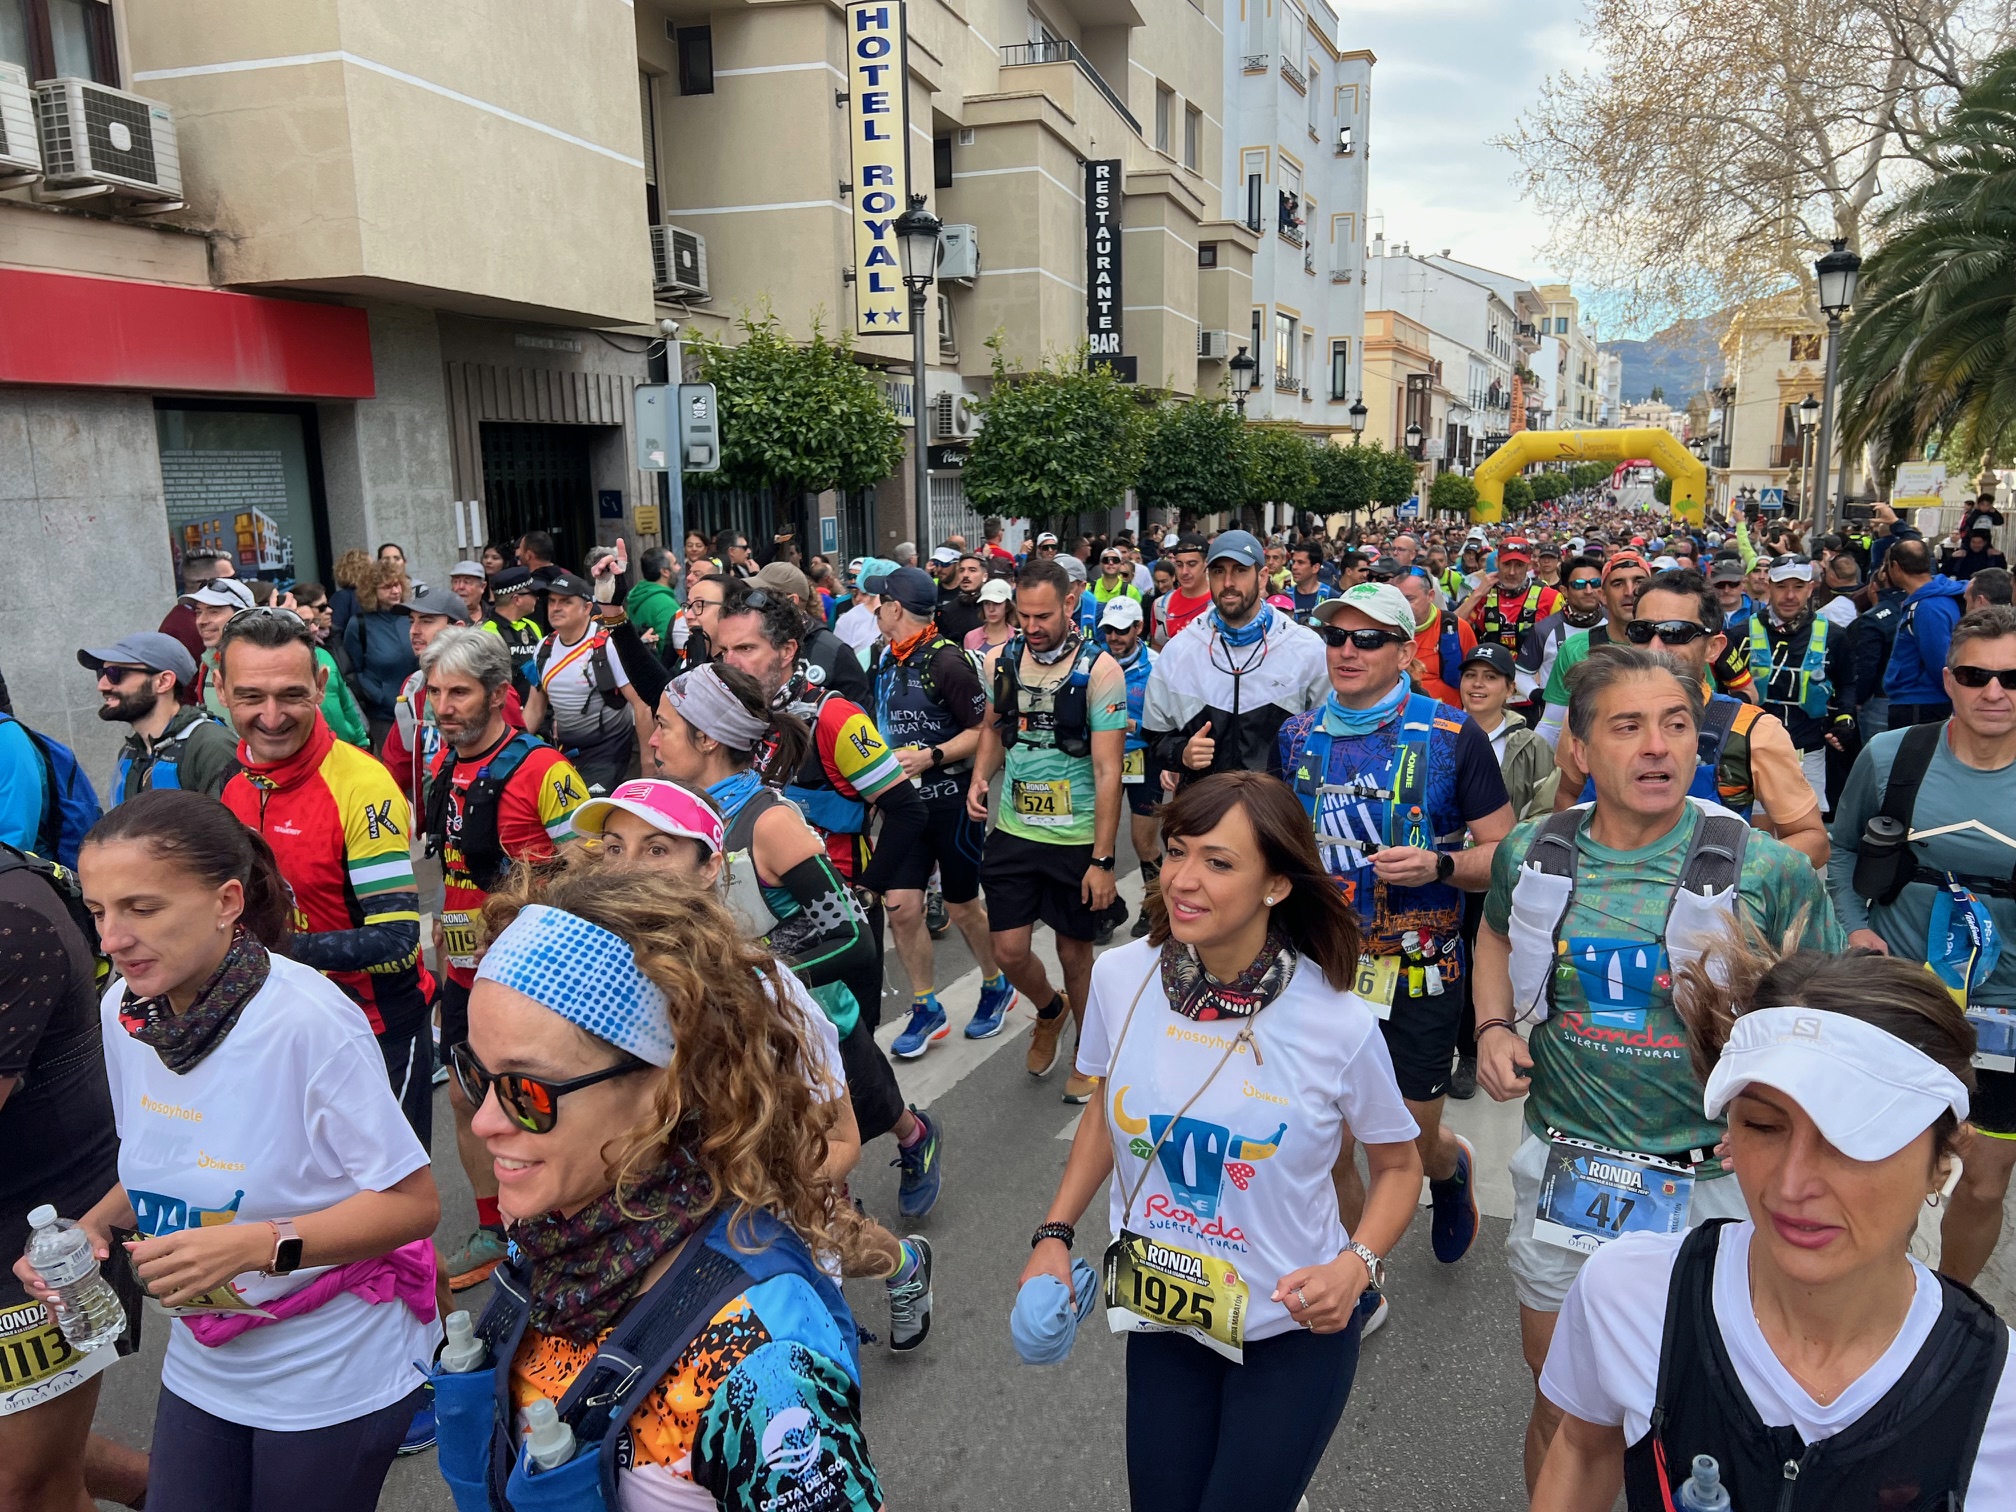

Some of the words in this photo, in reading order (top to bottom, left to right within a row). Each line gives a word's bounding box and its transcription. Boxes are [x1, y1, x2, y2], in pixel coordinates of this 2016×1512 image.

[856, 7, 890, 141] HOTEL
[862, 164, 897, 293] ROYAL
[1094, 165, 1113, 329] RESTAURANTE
[1090, 333, 1120, 354] BAR
[885, 381, 914, 417] ROYA
[510, 645, 536, 656] POLIC
[886, 720, 941, 735] MARATÓN
[890, 710, 928, 721] MEDIA
[1405, 751, 1418, 788] AONIJIE
[918, 779, 959, 800] era
[1025, 783, 1050, 791] RONDA
[1024, 796, 1055, 812] 524
[366, 806, 378, 838] KABRAS
[383, 818, 397, 834] TRAIL
[443, 914, 469, 923] RONDA
[444, 930, 477, 951] 1119
[1559, 1012, 1686, 1048] Ronda
[1564, 1031, 1608, 1052] SUERTE
[1615, 1045, 1680, 1059] NATURAL
[140, 1094, 203, 1123] #yosoyhole
[1589, 1161, 1643, 1188] RONDA
[1144, 1194, 1251, 1246] Ronda
[1586, 1192, 1635, 1231] 47
[1149, 1220, 1193, 1234] SUERTE
[1196, 1232, 1248, 1253] NTURAL
[1147, 1244, 1202, 1277] RONDA
[1132, 1269, 1215, 1330] 1925
[1232, 1294, 1243, 1324] MARATÓN
[0, 1326, 71, 1383] 1113
[53, 1373, 83, 1392] BACA
[760, 1487, 804, 1511] COSTA
[804, 1472, 828, 1493] DEL
[827, 1456, 848, 1476] SOL
